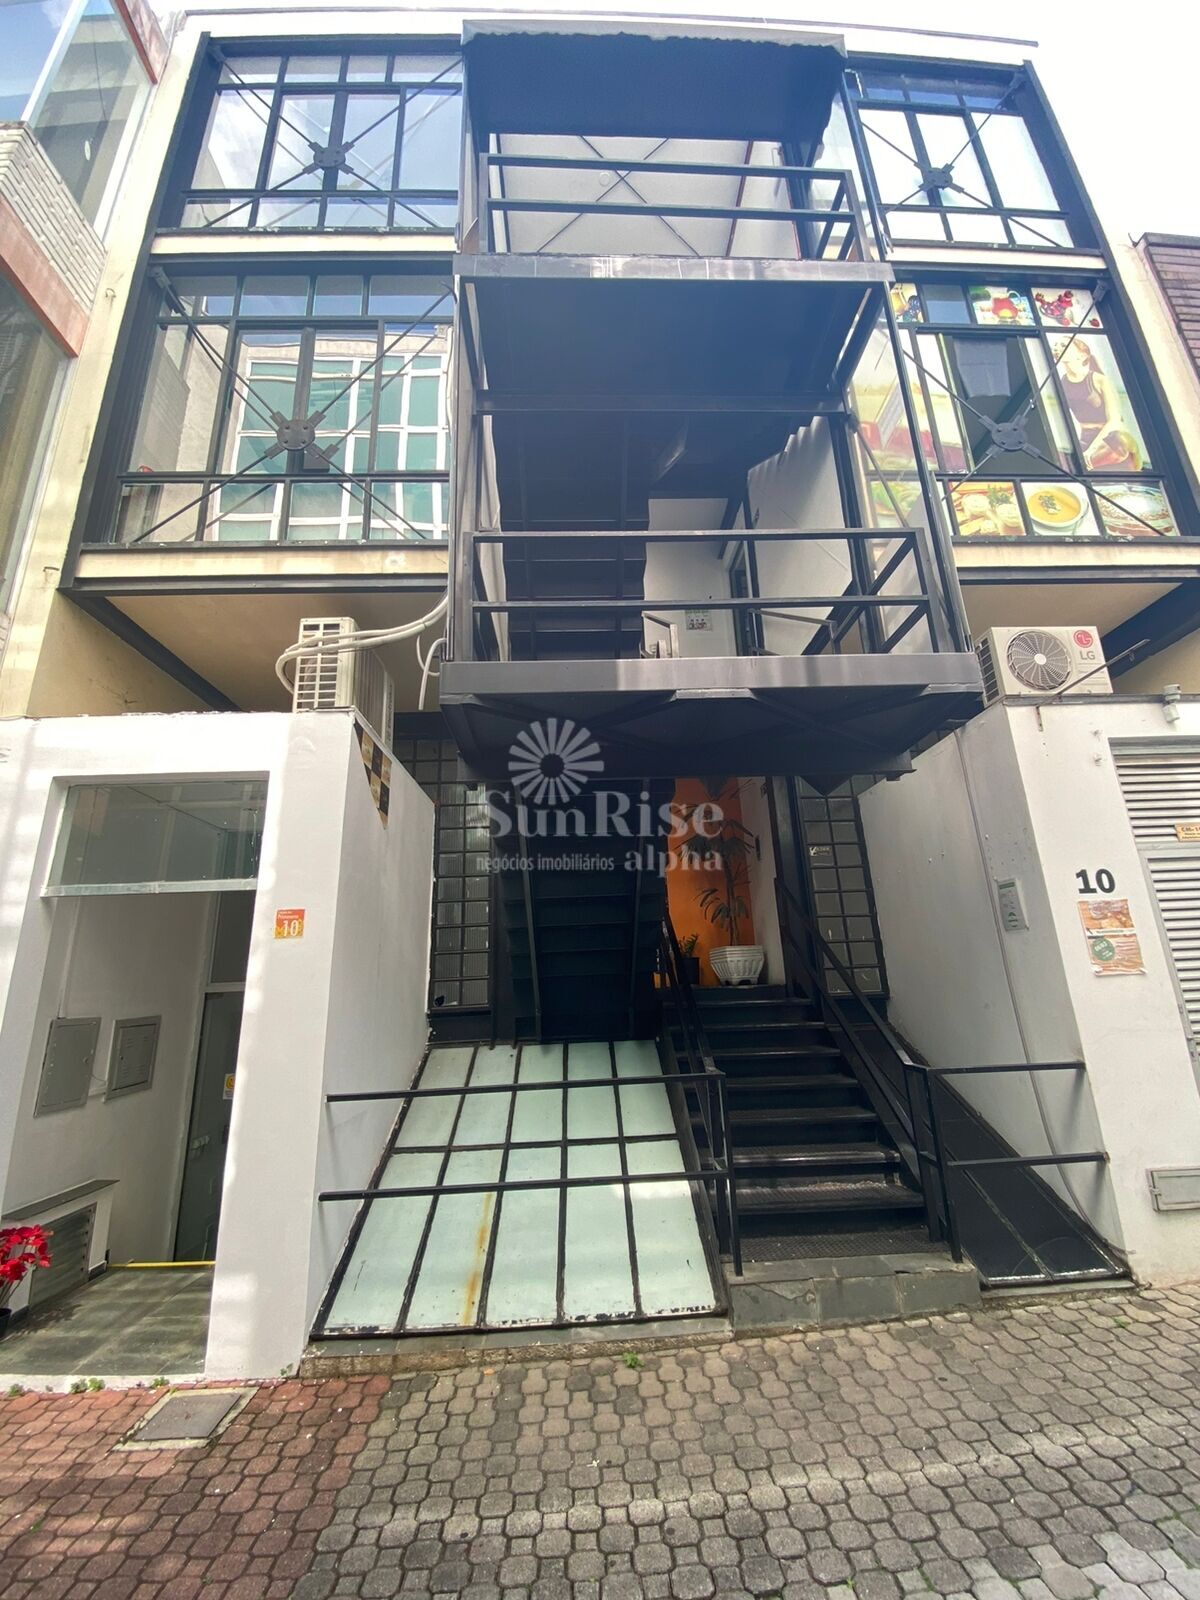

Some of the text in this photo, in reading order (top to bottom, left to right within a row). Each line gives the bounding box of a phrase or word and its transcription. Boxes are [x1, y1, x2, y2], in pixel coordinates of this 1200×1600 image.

[1080, 651, 1095, 660] LG
[1076, 869, 1115, 894] 10
[283, 920, 298, 936] 10
